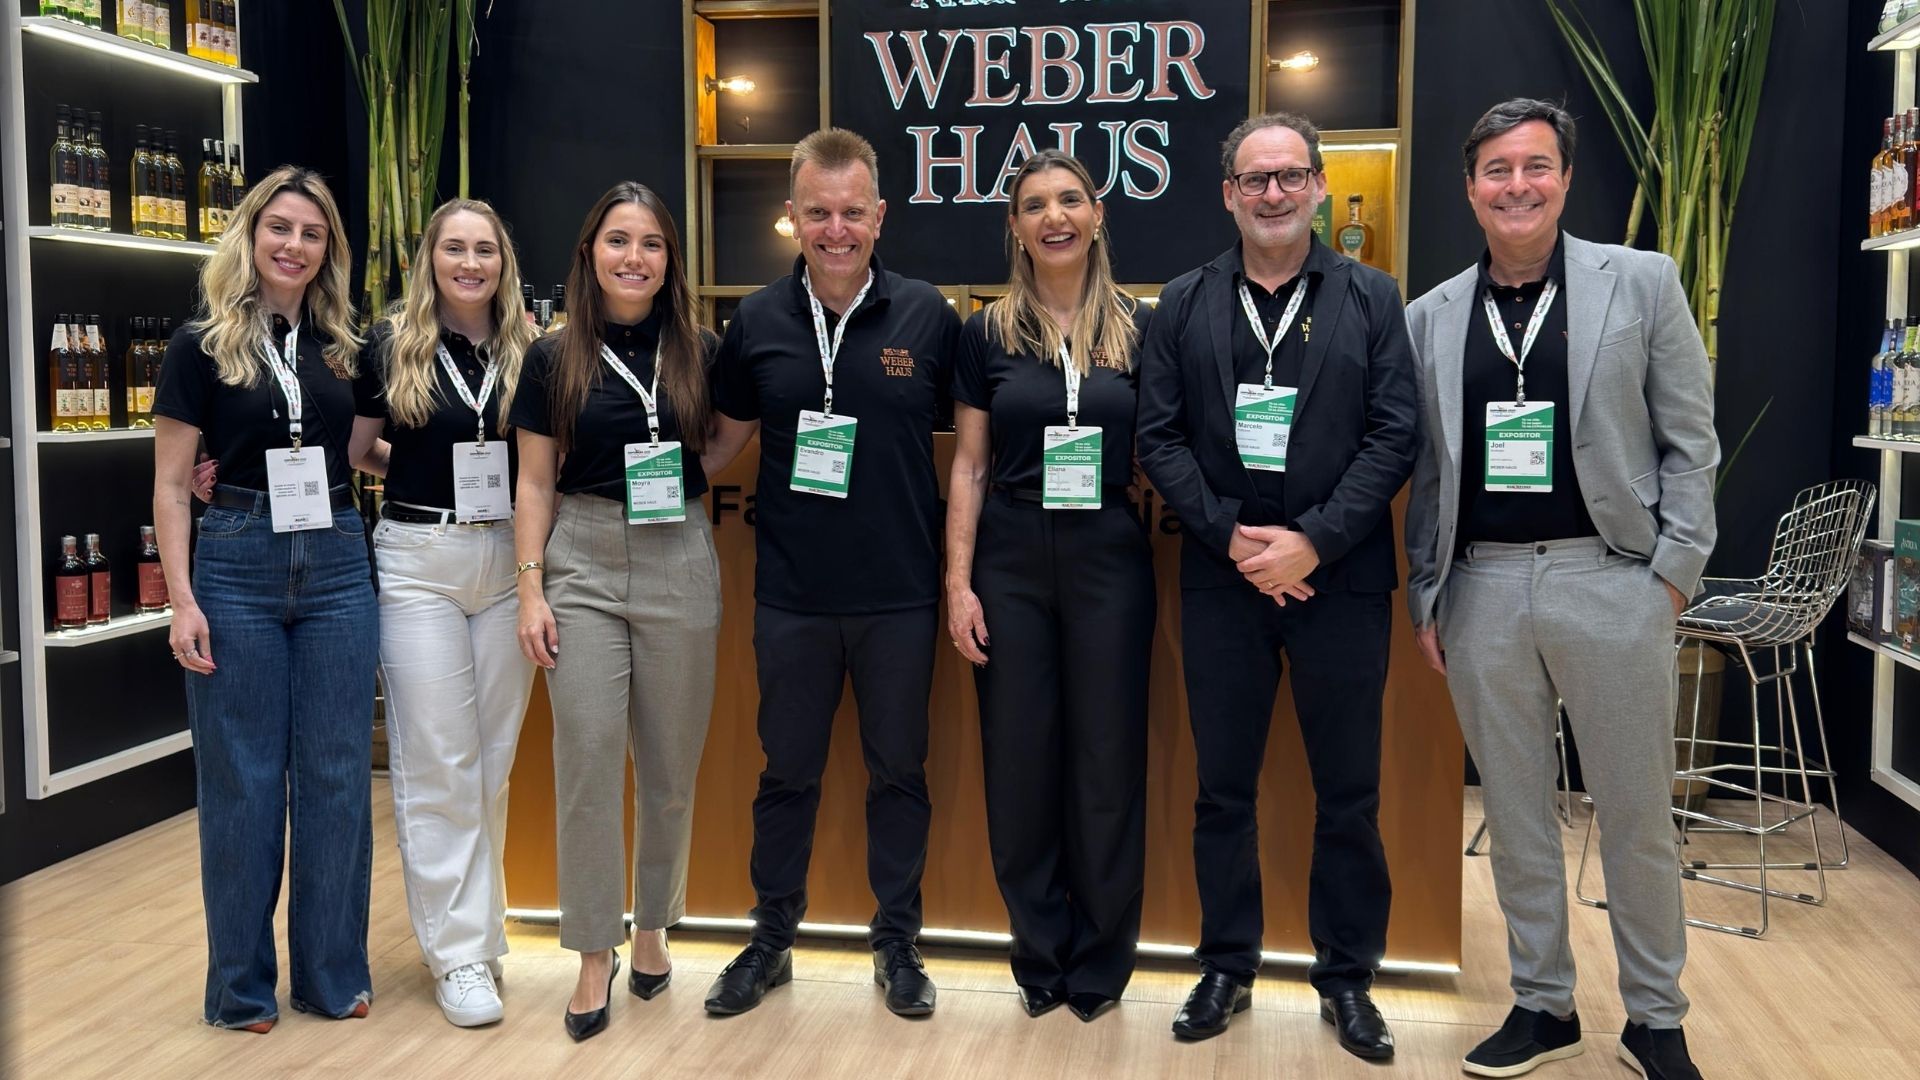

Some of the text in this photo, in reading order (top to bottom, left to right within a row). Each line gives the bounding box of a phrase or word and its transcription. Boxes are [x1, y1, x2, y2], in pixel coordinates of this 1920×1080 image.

[864, 20, 1216, 110] WEBER
[905, 119, 1171, 204] HAUS
[880, 356, 915, 367] WEBER
[885, 366, 912, 377] HAUS
[1245, 413, 1285, 422] EXPOSITOR
[807, 439, 844, 450] EXPOSITOR
[800, 447, 824, 456] Evandro
